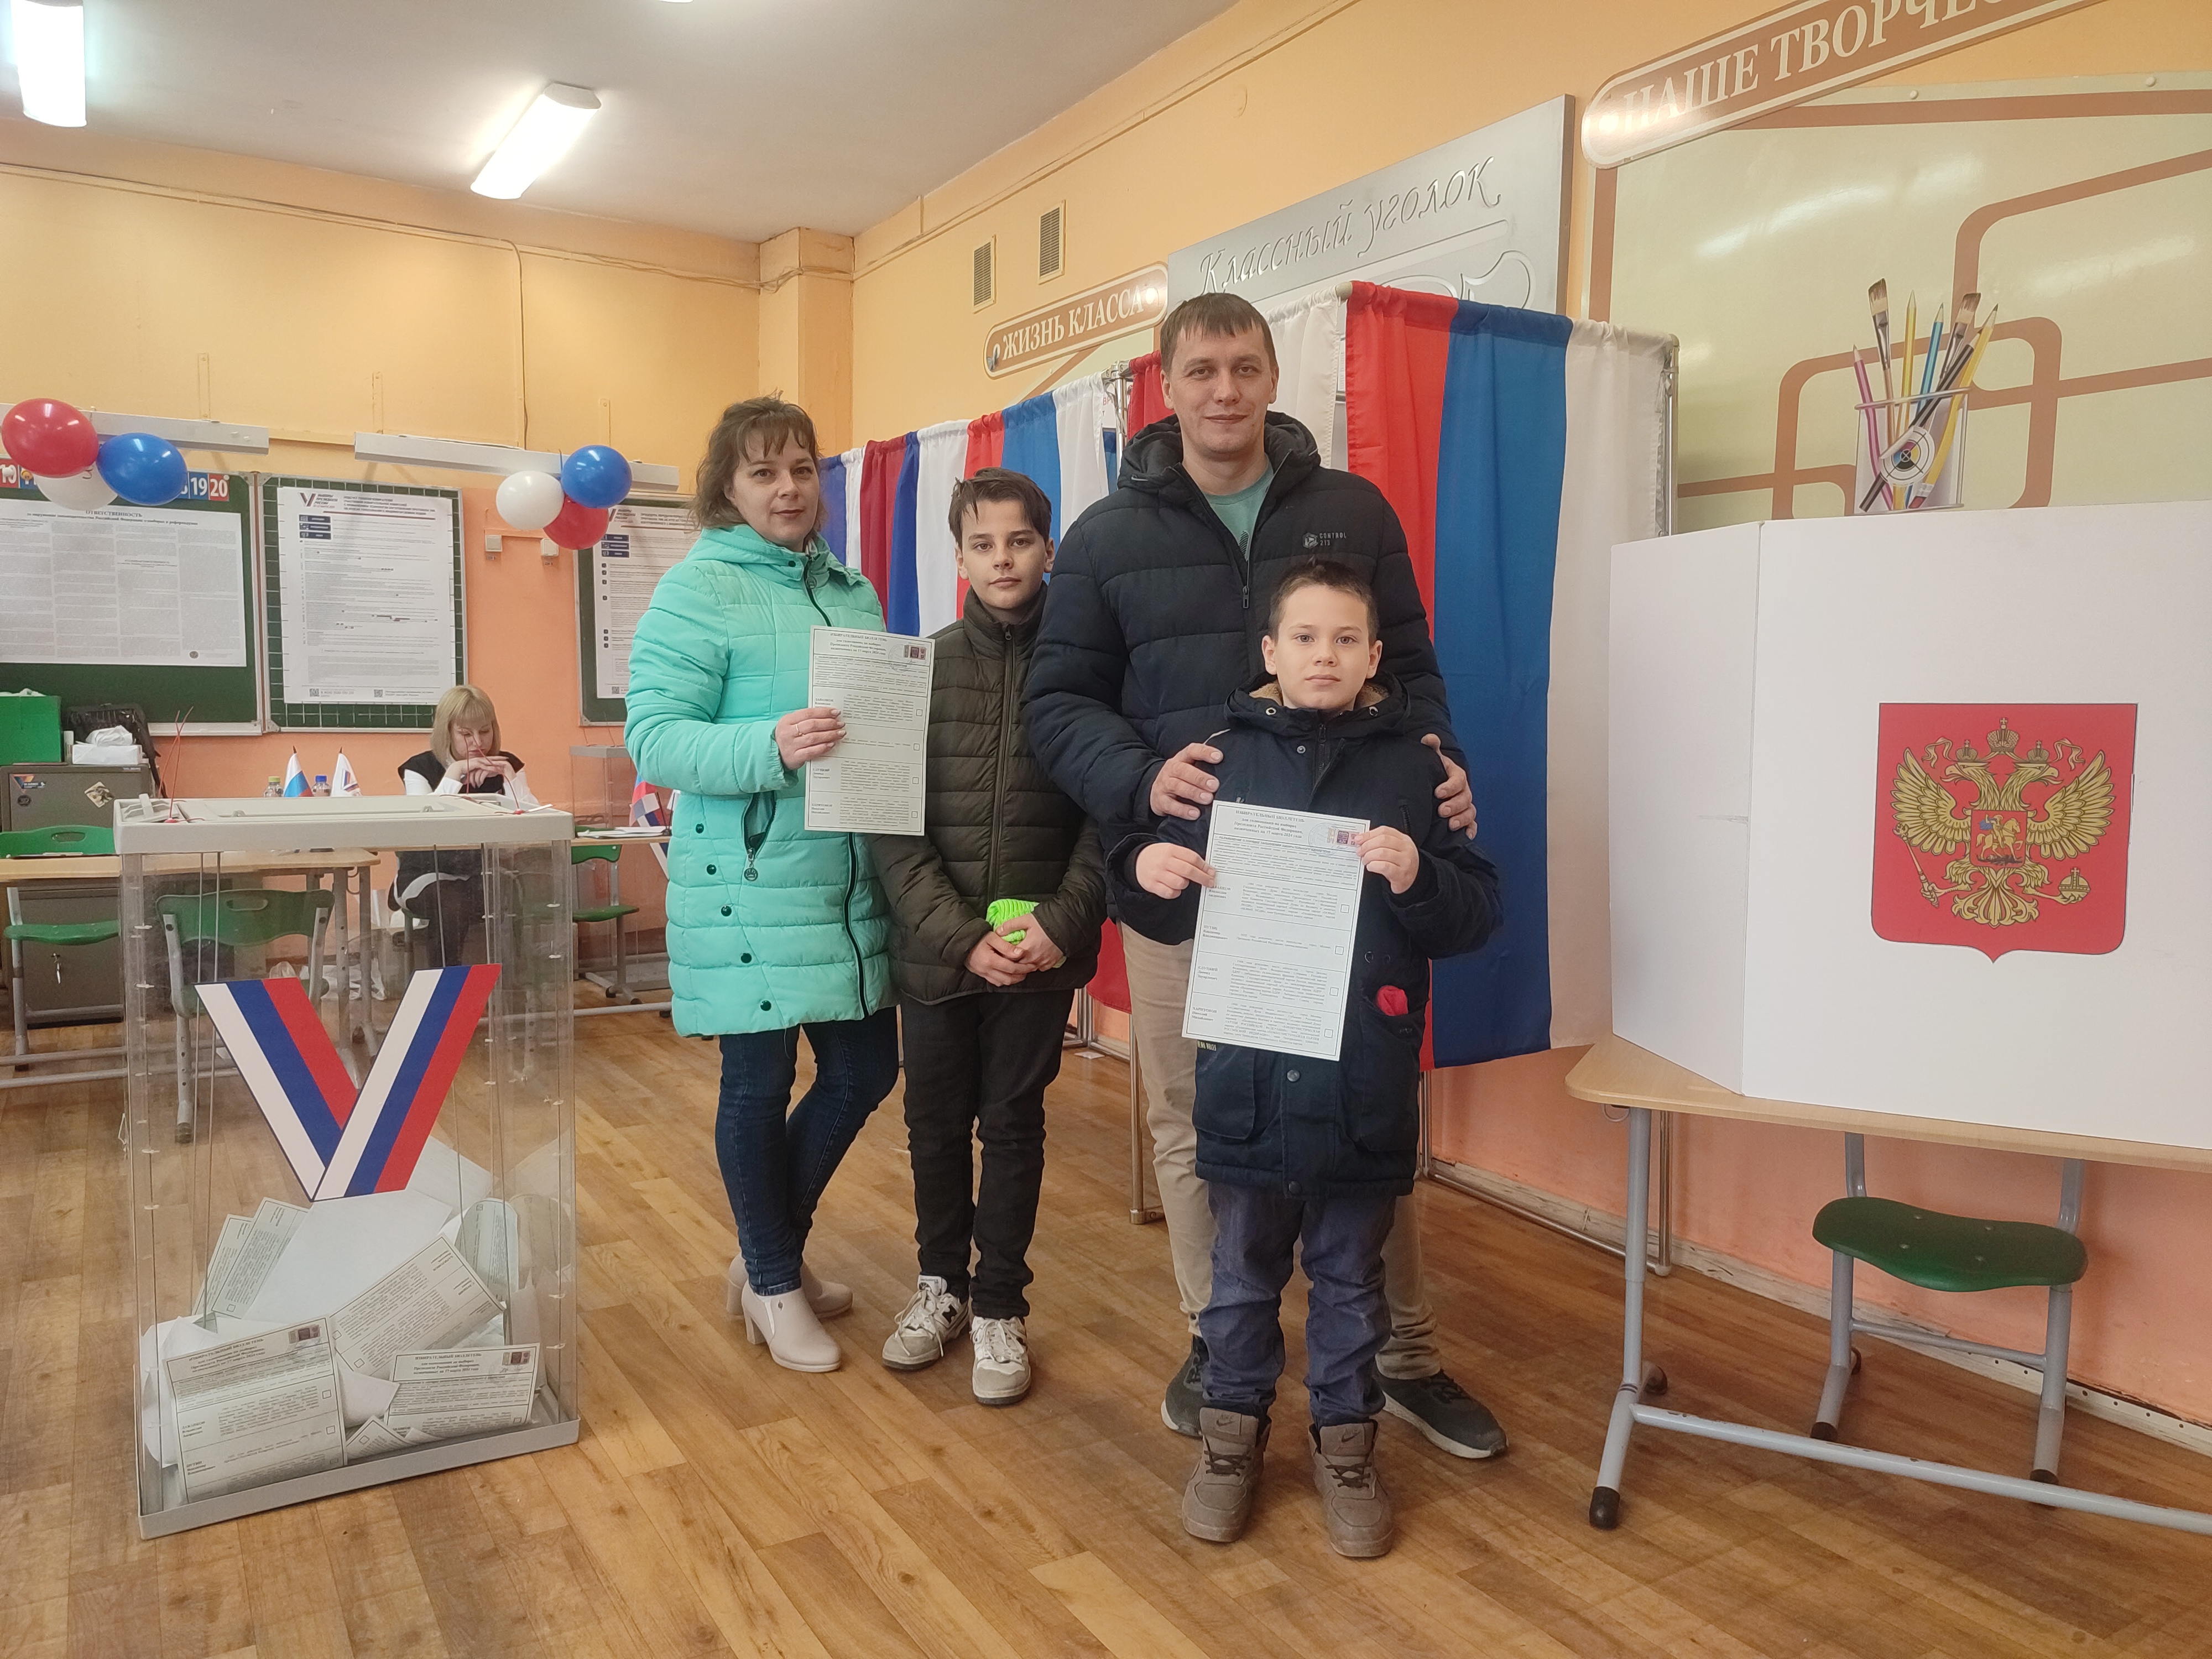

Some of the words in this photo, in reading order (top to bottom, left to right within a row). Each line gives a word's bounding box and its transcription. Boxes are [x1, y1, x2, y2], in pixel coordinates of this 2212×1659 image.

[1624, 44, 1759, 132] НАШЕ
[1200, 199, 1354, 296] Классный
[1358, 156, 1501, 258] уголок
[1002, 314, 1065, 361] ЖИЗНЬ
[1068, 285, 1144, 337] КЛАССА
[190, 477, 208, 496] 19
[210, 478, 228, 497] 20
[1235, 810, 1275, 818] ИЗБИРАТЕЛЬНЫЙ
